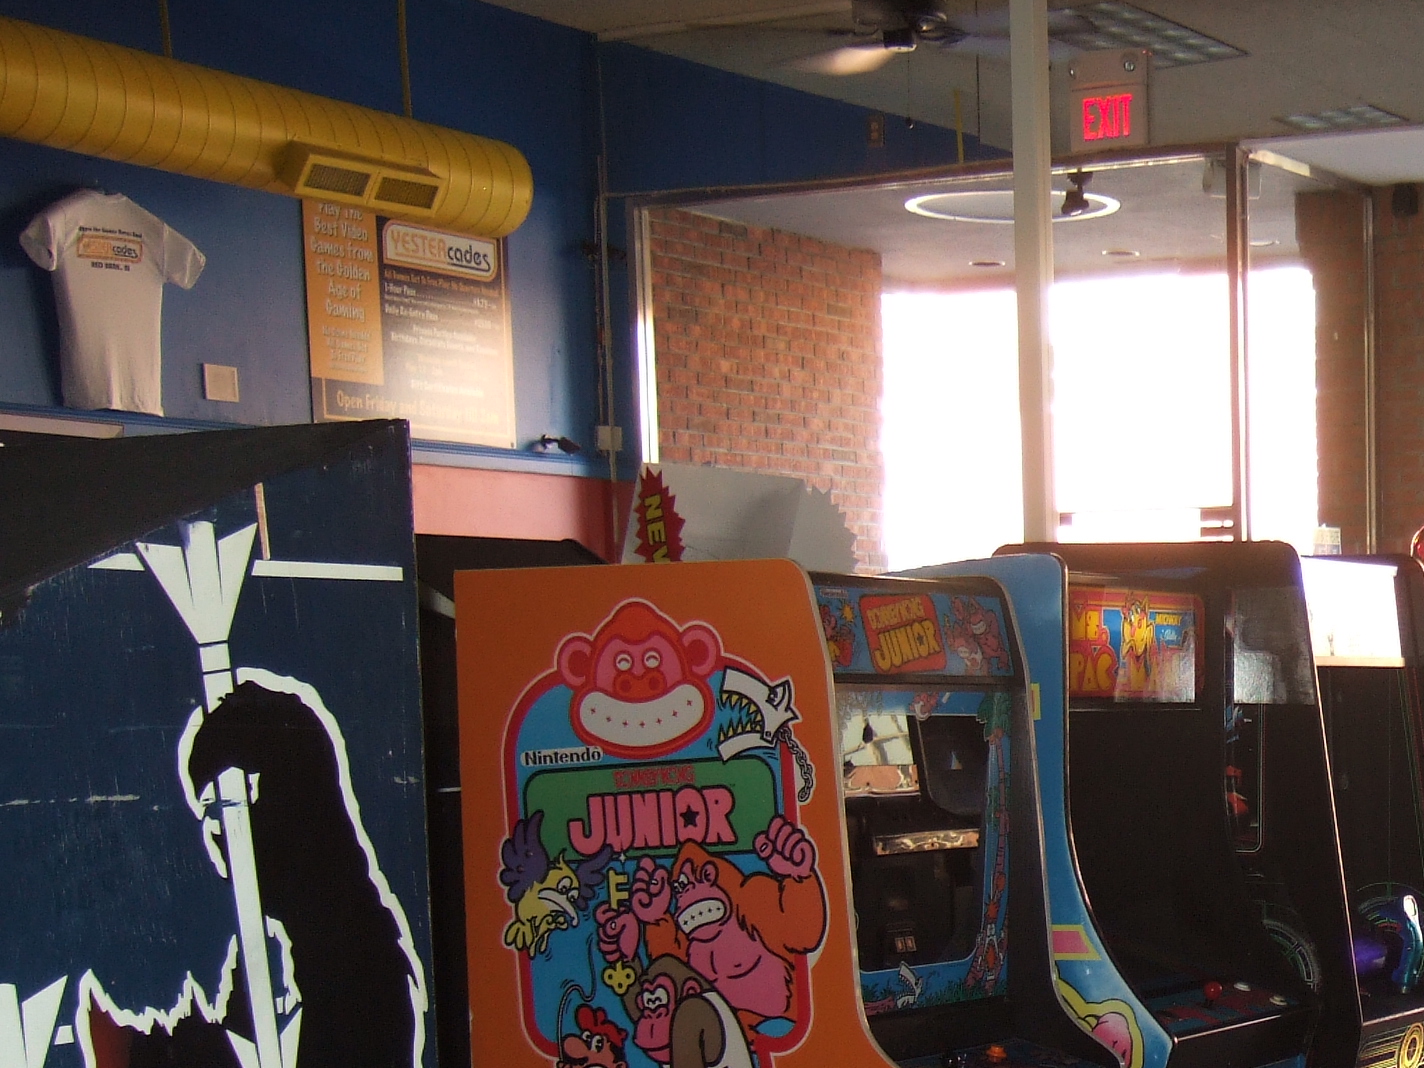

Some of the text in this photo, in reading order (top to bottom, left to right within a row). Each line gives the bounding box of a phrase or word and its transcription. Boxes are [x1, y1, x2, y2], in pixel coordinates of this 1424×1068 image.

[1083, 94, 1132, 140] EXIT
[391, 230, 491, 272] YESTERcades
[873, 620, 942, 671] JUNIOR
[524, 747, 601, 766] Nintendo
[567, 784, 739, 857] JUNIOR
